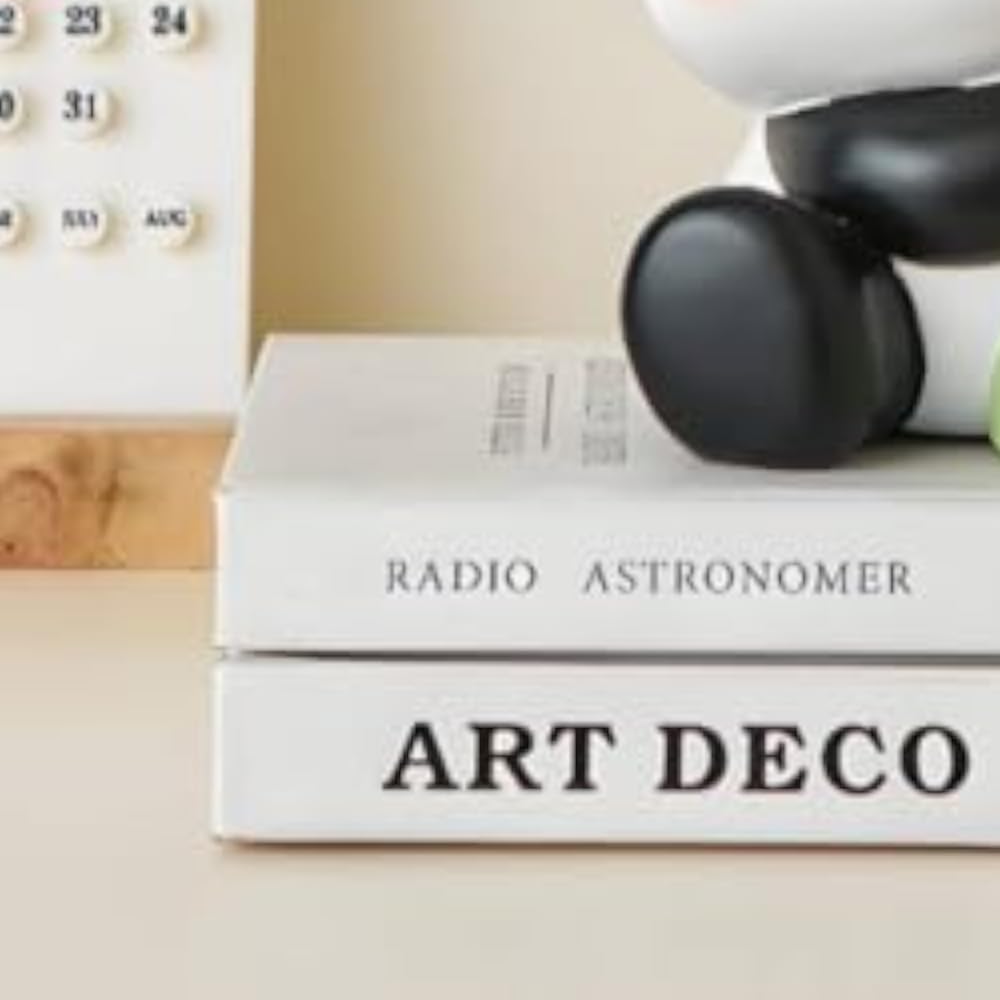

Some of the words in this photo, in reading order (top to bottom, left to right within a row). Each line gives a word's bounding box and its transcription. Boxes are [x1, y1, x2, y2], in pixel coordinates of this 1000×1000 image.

[65, 5, 102, 36] 23
[152, 5, 188, 35] 24
[63, 90, 96, 120] 31
[385, 558, 539, 594] RADIO
[582, 559, 913, 595] ASTRONOMER
[382, 721, 617, 792] ART
[656, 724, 972, 796] DECO
